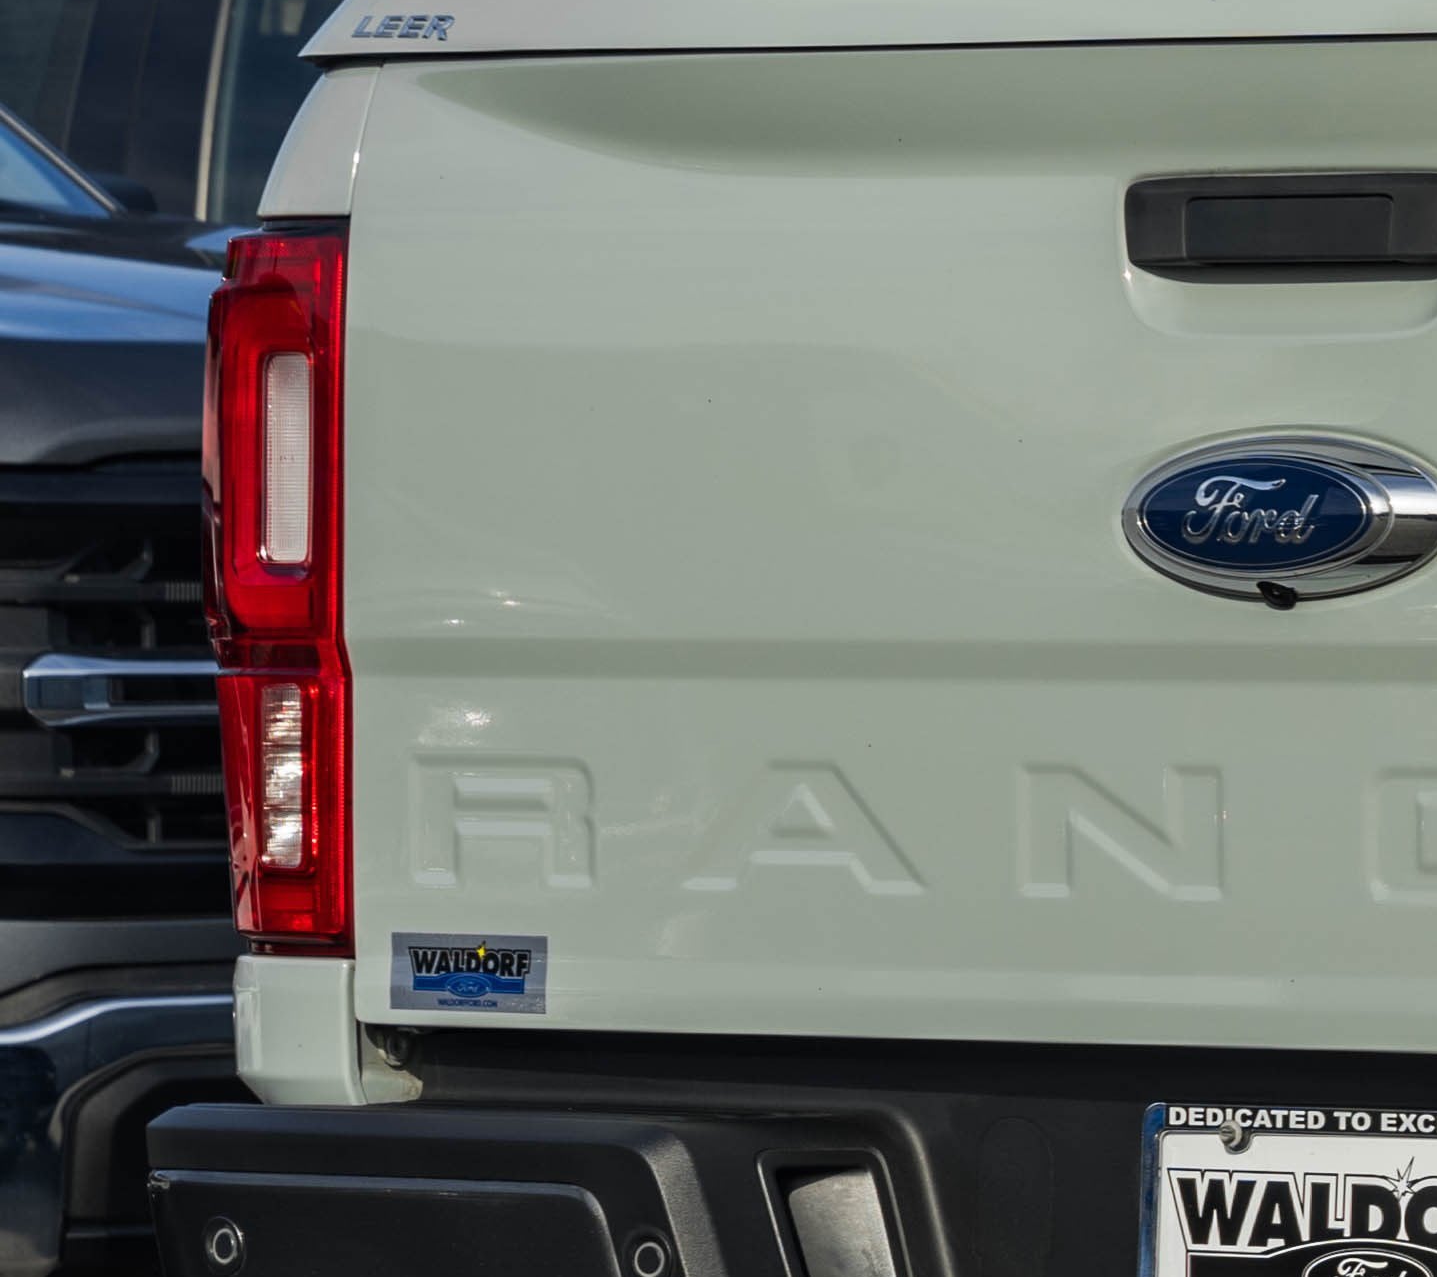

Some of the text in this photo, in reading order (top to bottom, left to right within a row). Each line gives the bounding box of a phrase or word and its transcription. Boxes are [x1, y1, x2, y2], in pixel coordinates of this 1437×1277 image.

[351, 14, 455, 41] LEER
[1181, 474, 1320, 545] Ford
[409, 946, 532, 978] WALDORF
[1168, 1105, 1325, 1131] DEDICATED
[1333, 1110, 1372, 1131] TO
